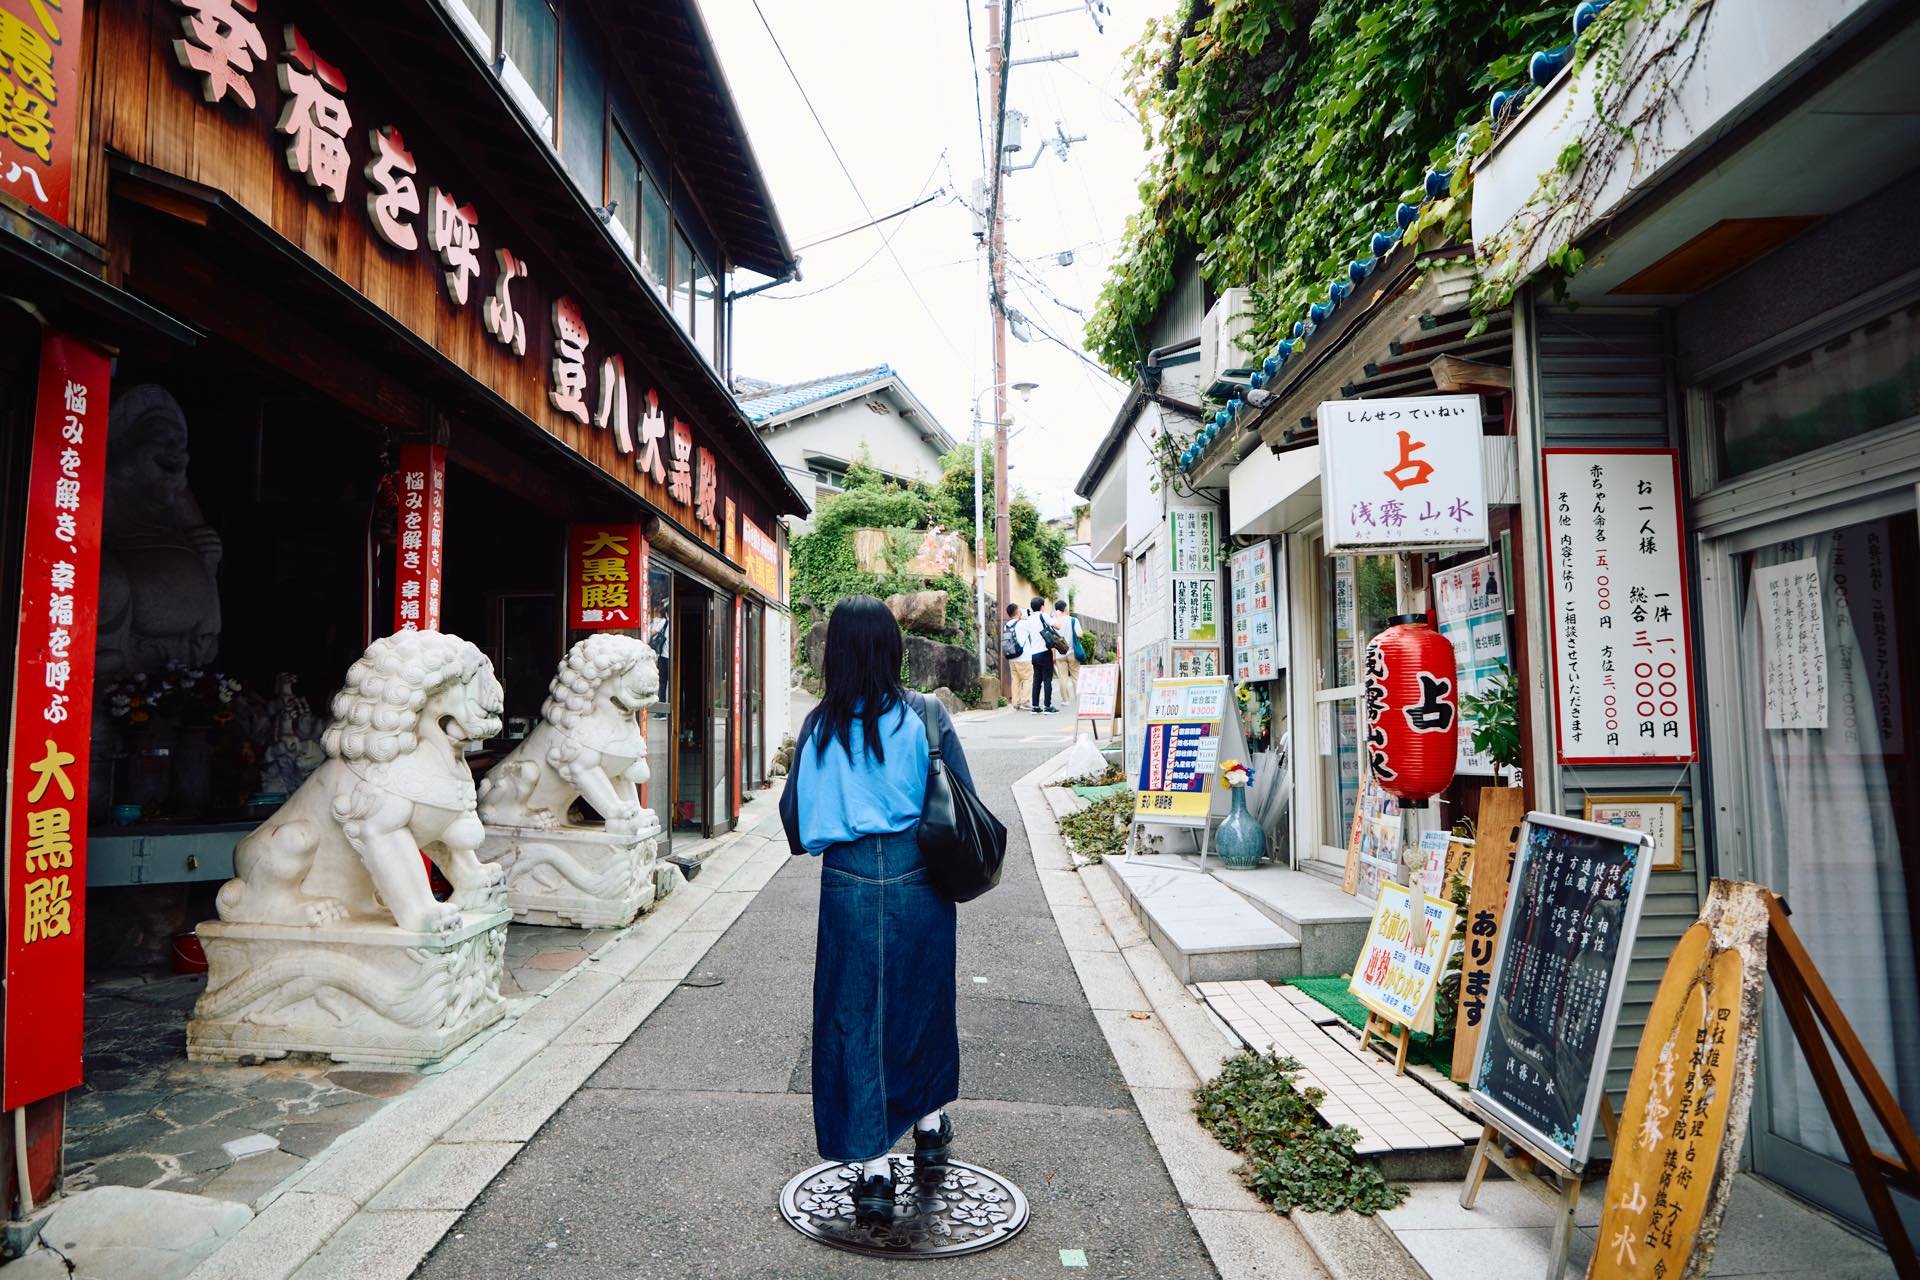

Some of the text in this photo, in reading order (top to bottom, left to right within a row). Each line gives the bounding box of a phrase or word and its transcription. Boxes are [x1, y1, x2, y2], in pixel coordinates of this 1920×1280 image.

[1347, 406, 1465, 423] しんせつ ていねい
[1384, 430, 1434, 491] 占
[1351, 497, 1474, 527] 浅霧 山水
[1557, 491, 1571, 527] その他
[1590, 464, 1606, 542] 赤ちゃん命名
[1637, 479, 1657, 555] お一人様
[582, 532, 630, 608] 大黒殿
[1203, 582, 1213, 622] 人生相談
[1629, 586, 1649, 624] 総合
[24, 380, 88, 944] 悩みを解き、幸福を呼ぶ 大黒殿
[1405, 675, 1453, 730] 占
[1564, 856, 1579, 886] 方位
[1591, 862, 1606, 896] 健康
[1605, 865, 1621, 900] 結婚
[1581, 914, 1593, 949] 仕事
[1594, 917, 1609, 952] 相性
[1463, 909, 1497, 1027] あります
